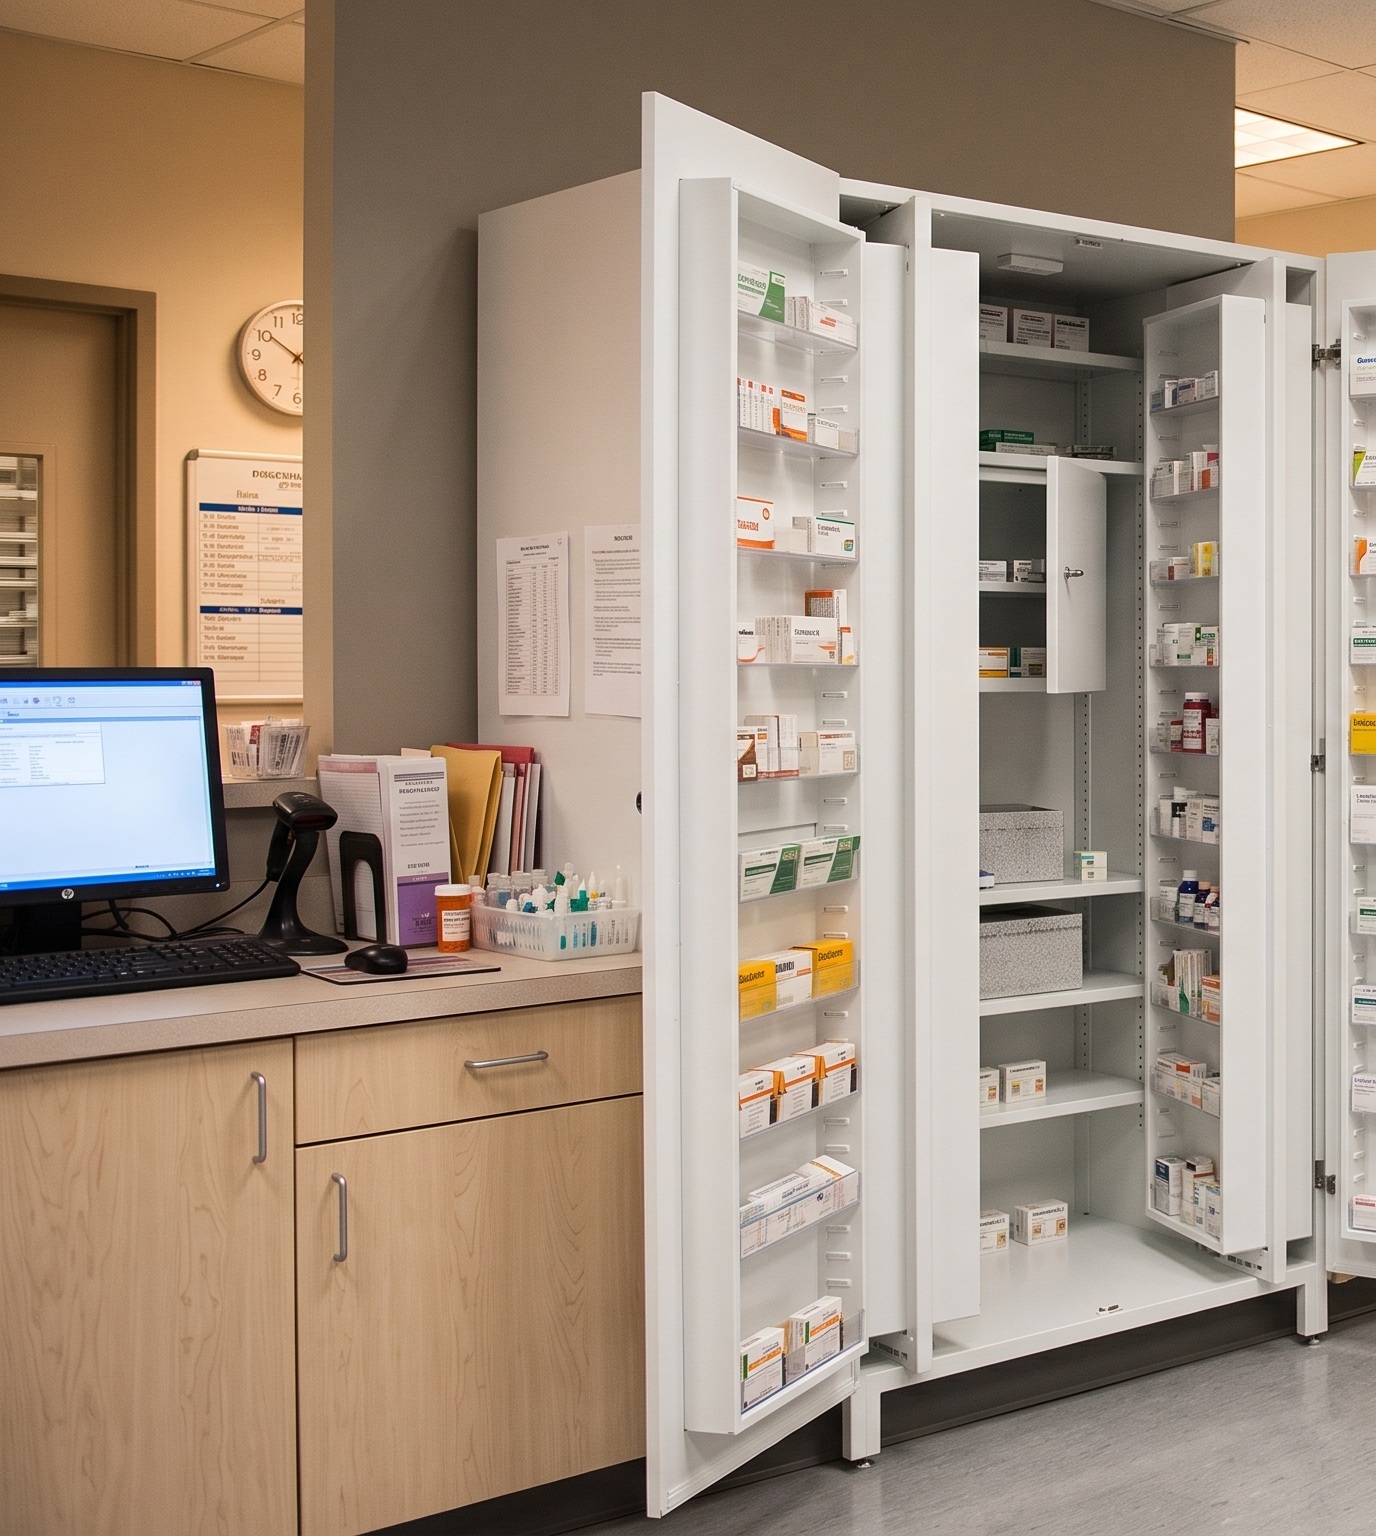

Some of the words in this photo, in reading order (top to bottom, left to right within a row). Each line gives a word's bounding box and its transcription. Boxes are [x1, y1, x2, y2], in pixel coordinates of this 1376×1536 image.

[273, 315, 284, 329] 11
[257, 329, 272, 343] 10
[251, 348, 261, 361] 9
[257, 368, 267, 381] 8
[273, 384, 282, 397] 7
[292, 392, 302, 404] 6
